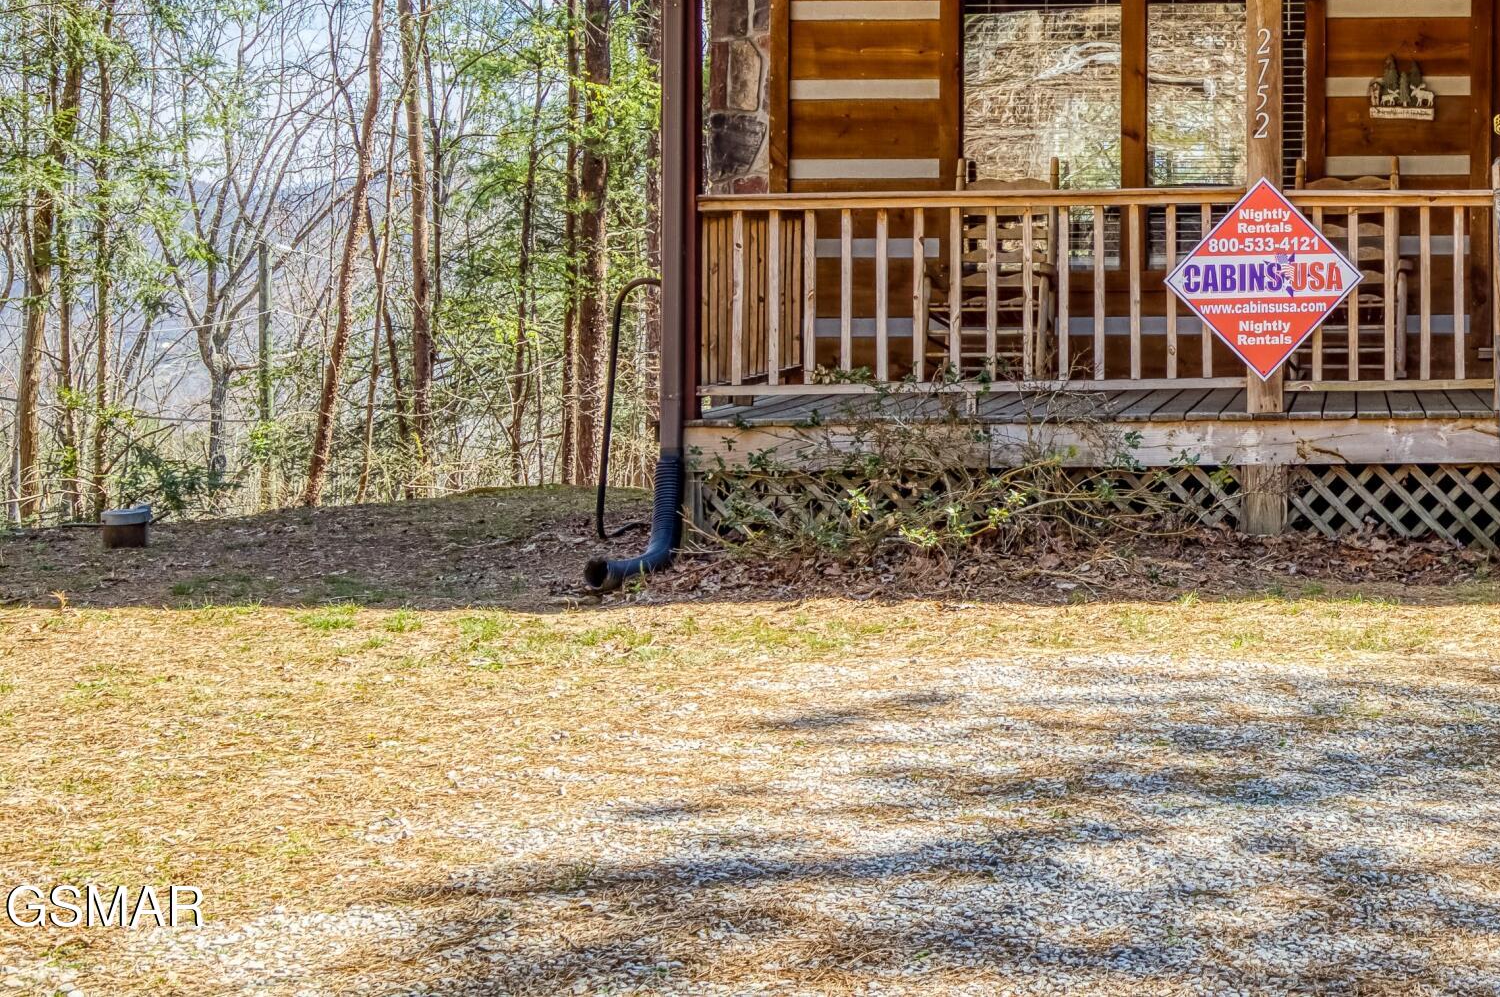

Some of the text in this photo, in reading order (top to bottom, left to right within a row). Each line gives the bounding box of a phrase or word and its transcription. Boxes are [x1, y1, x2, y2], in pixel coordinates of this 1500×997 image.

[1253, 28, 1271, 139] 2752
[1239, 208, 1291, 221] Nightly
[1237, 222, 1293, 233] Rentals
[1208, 236, 1319, 252] 800-533-4121
[1183, 261, 1343, 293] CABINS USA
[1200, 301, 1327, 314] www.cabinsusa.com
[1239, 320, 1291, 333] Nightly
[1237, 334, 1293, 345] Rentals
